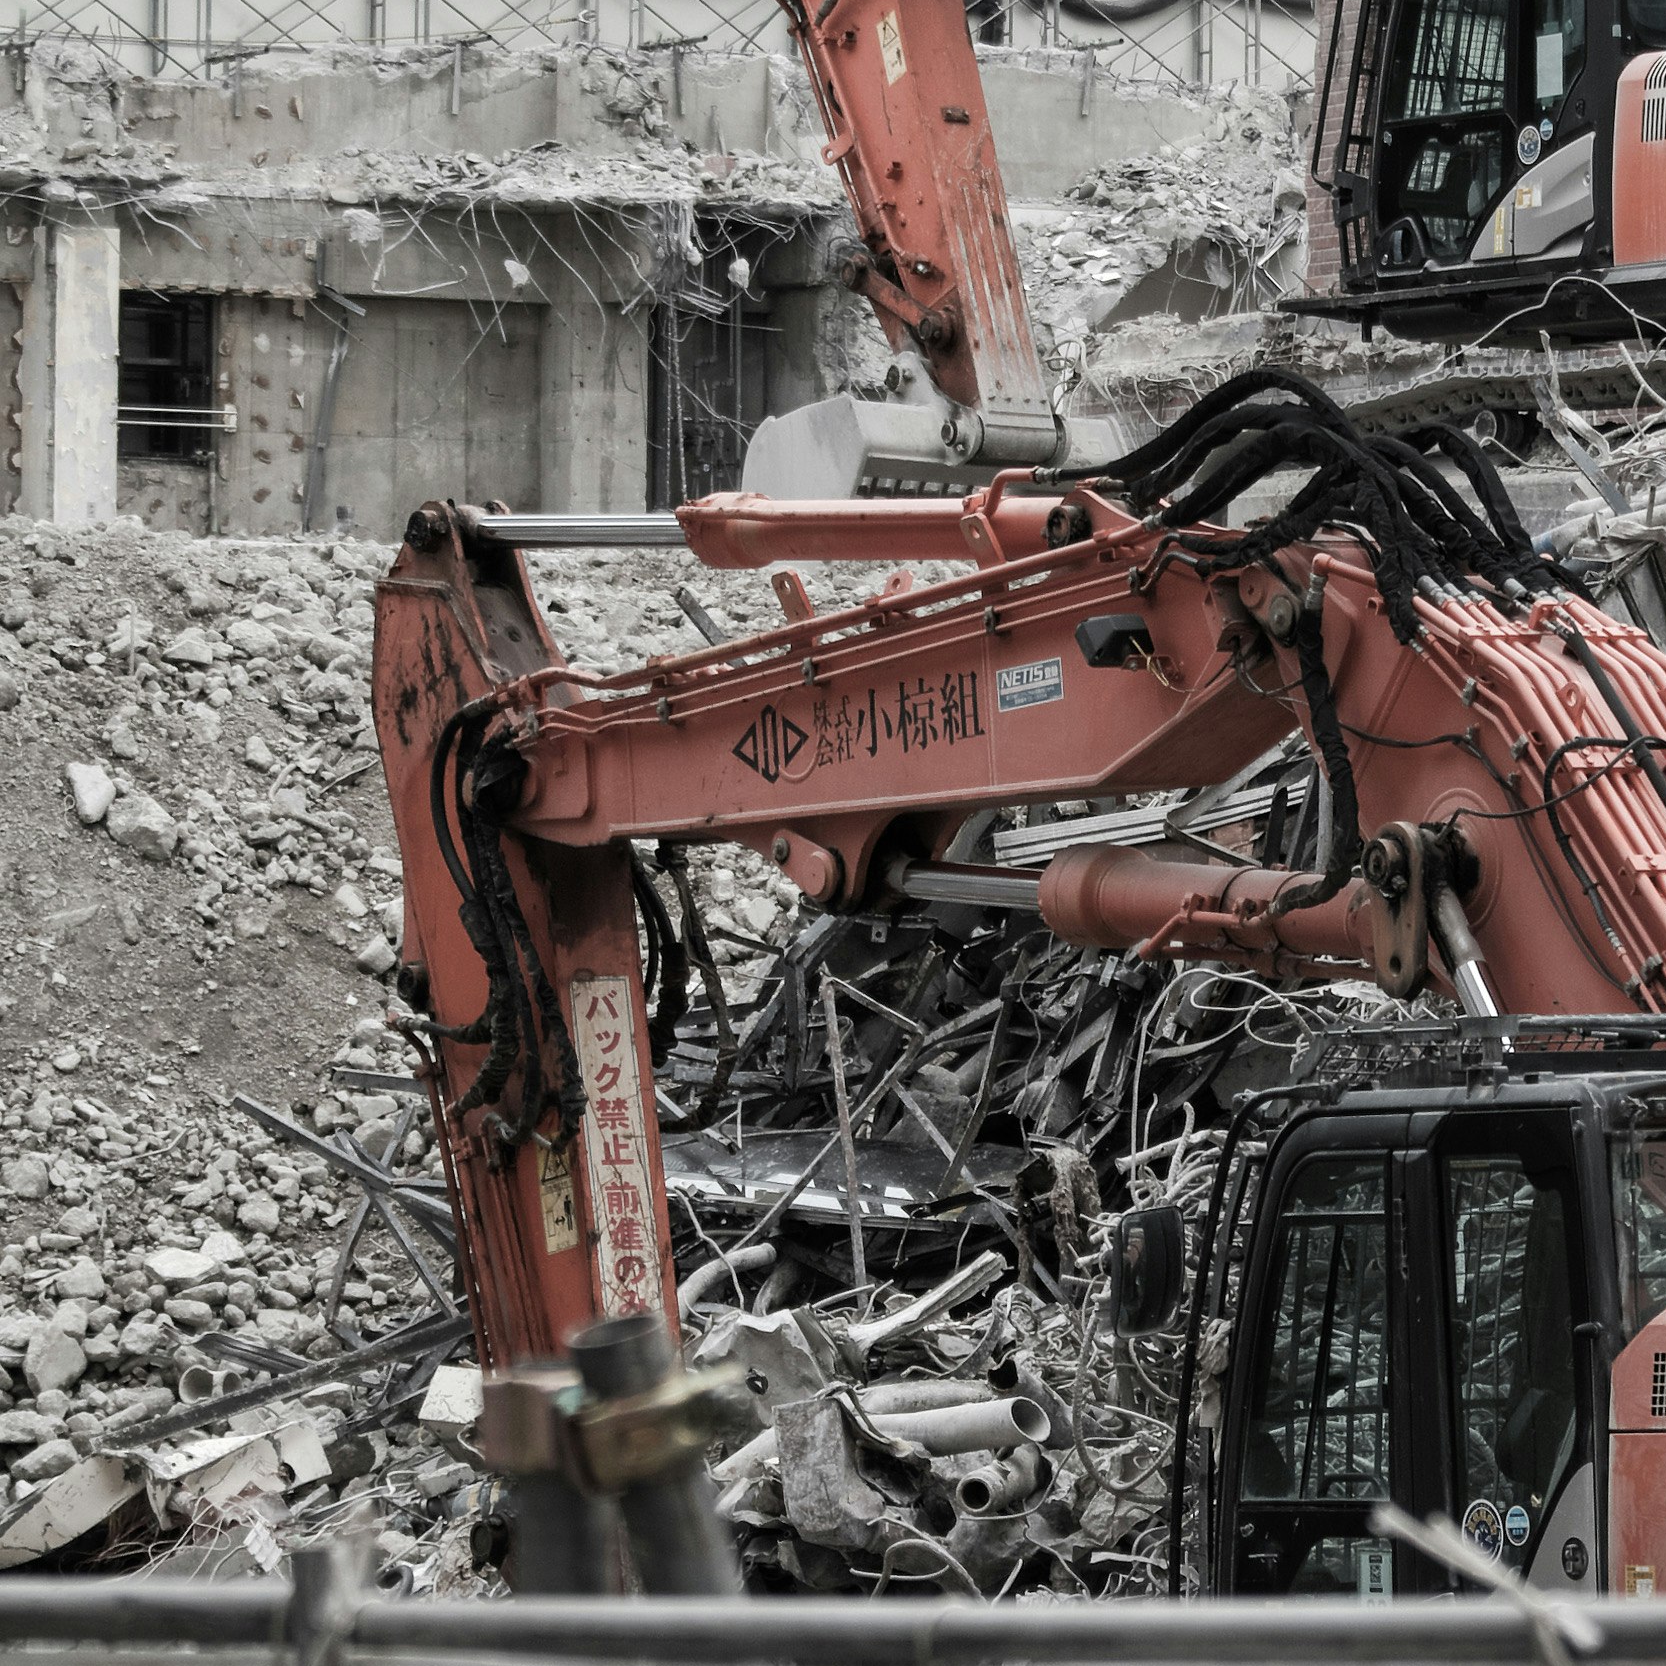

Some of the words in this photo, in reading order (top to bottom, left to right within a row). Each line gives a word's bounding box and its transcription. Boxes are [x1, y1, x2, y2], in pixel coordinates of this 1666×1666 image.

[584, 990, 635, 1166] バック禁止
